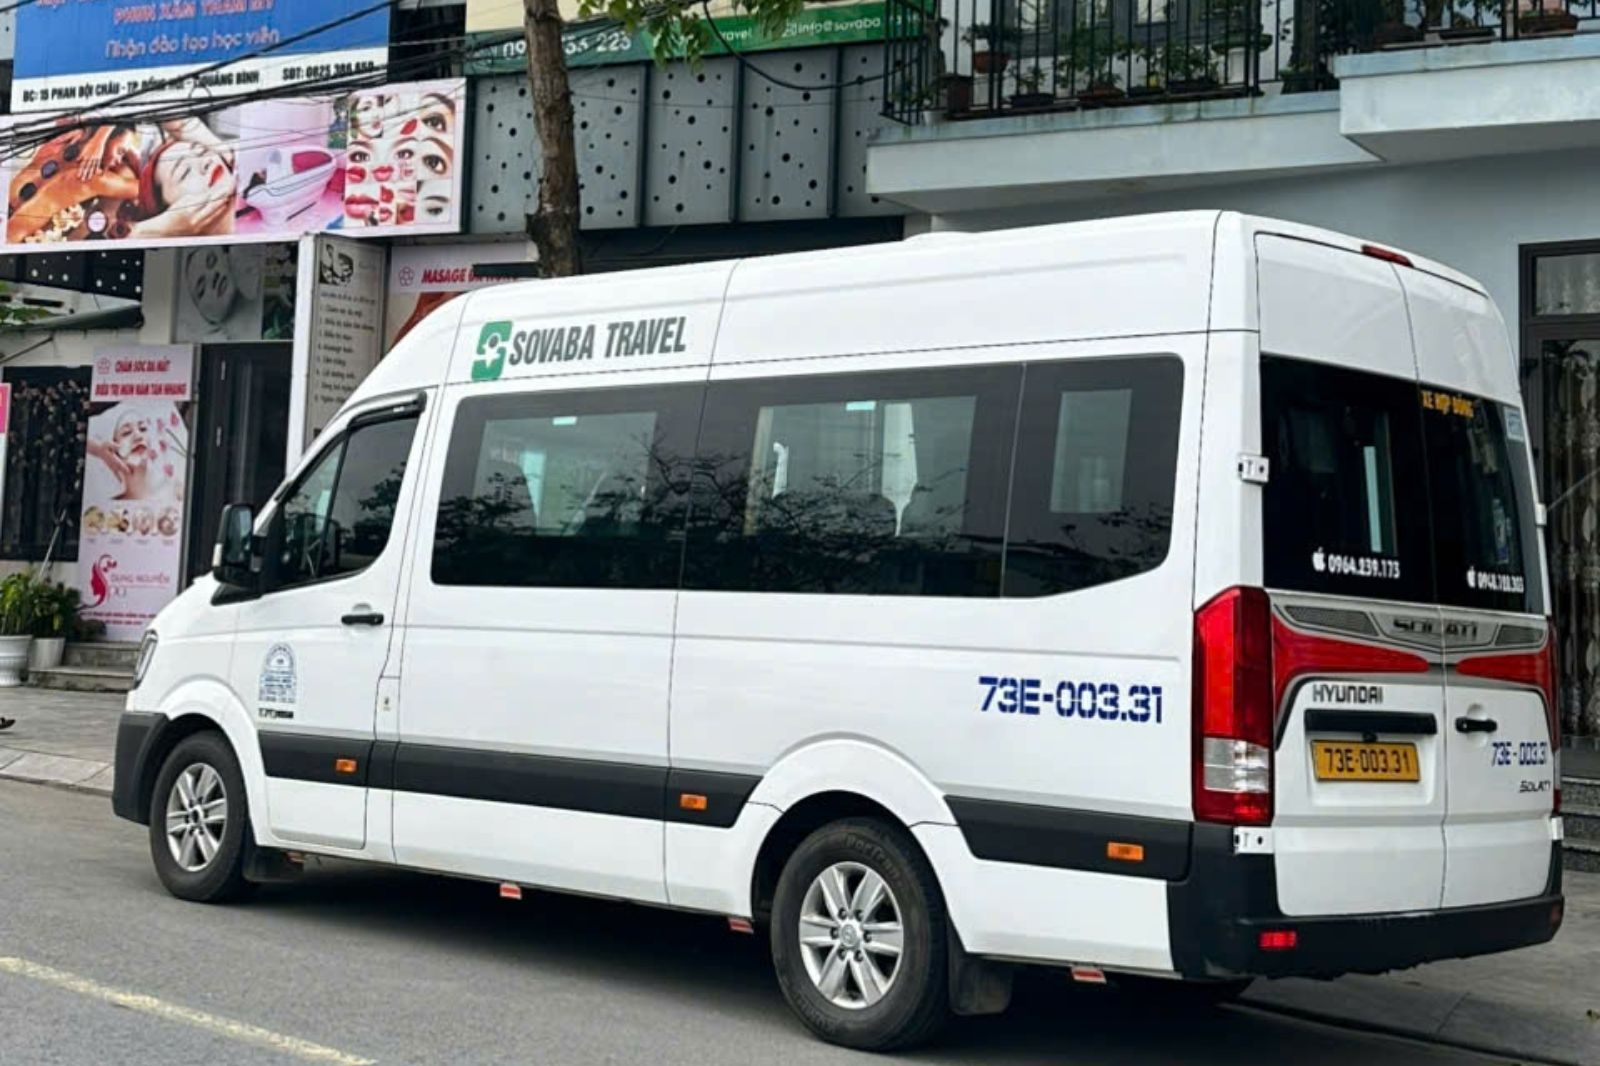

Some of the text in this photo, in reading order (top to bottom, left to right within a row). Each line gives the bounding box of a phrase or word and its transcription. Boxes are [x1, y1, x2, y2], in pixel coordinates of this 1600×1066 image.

[421, 266, 467, 284] MASAGE
[508, 316, 687, 366] SOVABA TRAVEL
[978, 675, 1163, 725] 73E-003.31
[1312, 684, 1384, 704] HYUNDAI
